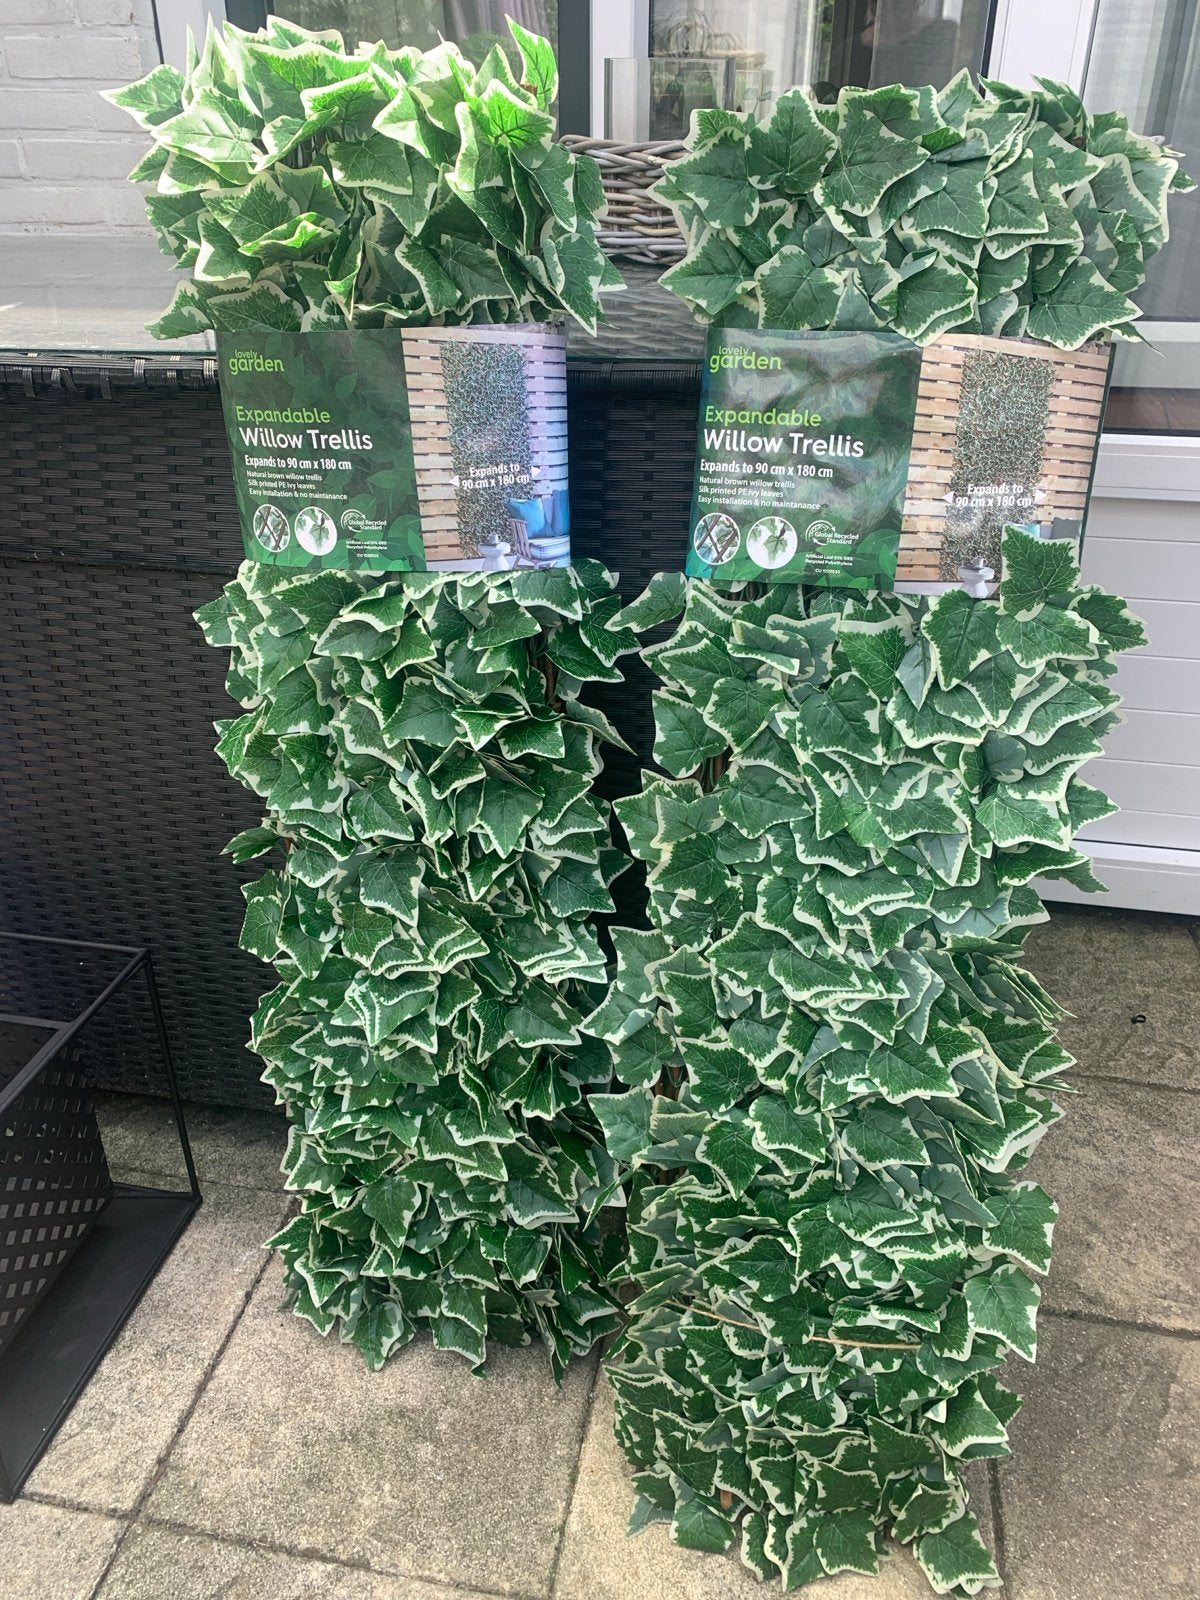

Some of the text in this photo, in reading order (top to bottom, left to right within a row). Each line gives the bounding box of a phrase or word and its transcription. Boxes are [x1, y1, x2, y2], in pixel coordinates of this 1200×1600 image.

[235, 349, 258, 361] lovely
[718, 345, 749, 357] lovely
[229, 355, 284, 376] garden
[709, 352, 782, 373] garden
[235, 405, 330, 425] Expandable
[705, 405, 822, 426] Expandable
[239, 427, 373, 450] Willow Trellis
[703, 428, 864, 458] Willow Trellis
[244, 454, 352, 470] Expands to 90 cm x 180 cm
[700, 459, 833, 478] Expands to 90 cm x 180 cm
[246, 470, 323, 481] Natural brown willow trellis
[470, 463, 520, 478] Expands to
[259, 480, 278, 488] printed
[287, 481, 296, 490] ivy
[297, 481, 316, 490] leaves
[462, 474, 530, 490] 90 cm x 180 cm
[700, 476, 795, 488] Natural brown willow trellis
[249, 488, 262, 496] Easy
[263, 489, 293, 498] installation
[309, 492, 348, 500] maintanance
[698, 485, 784, 498] Silk printed PE ivy leaves
[968, 483, 1023, 496] Expands to
[697, 495, 712, 504] Easy
[712, 496, 752, 506] installation
[753, 498, 759, 506] &
[772, 499, 821, 510] maintanance
[956, 495, 1032, 507] 90 cm x 180 cm
[826, 537, 852, 545] Standard
[833, 532, 859, 540] Recycled
